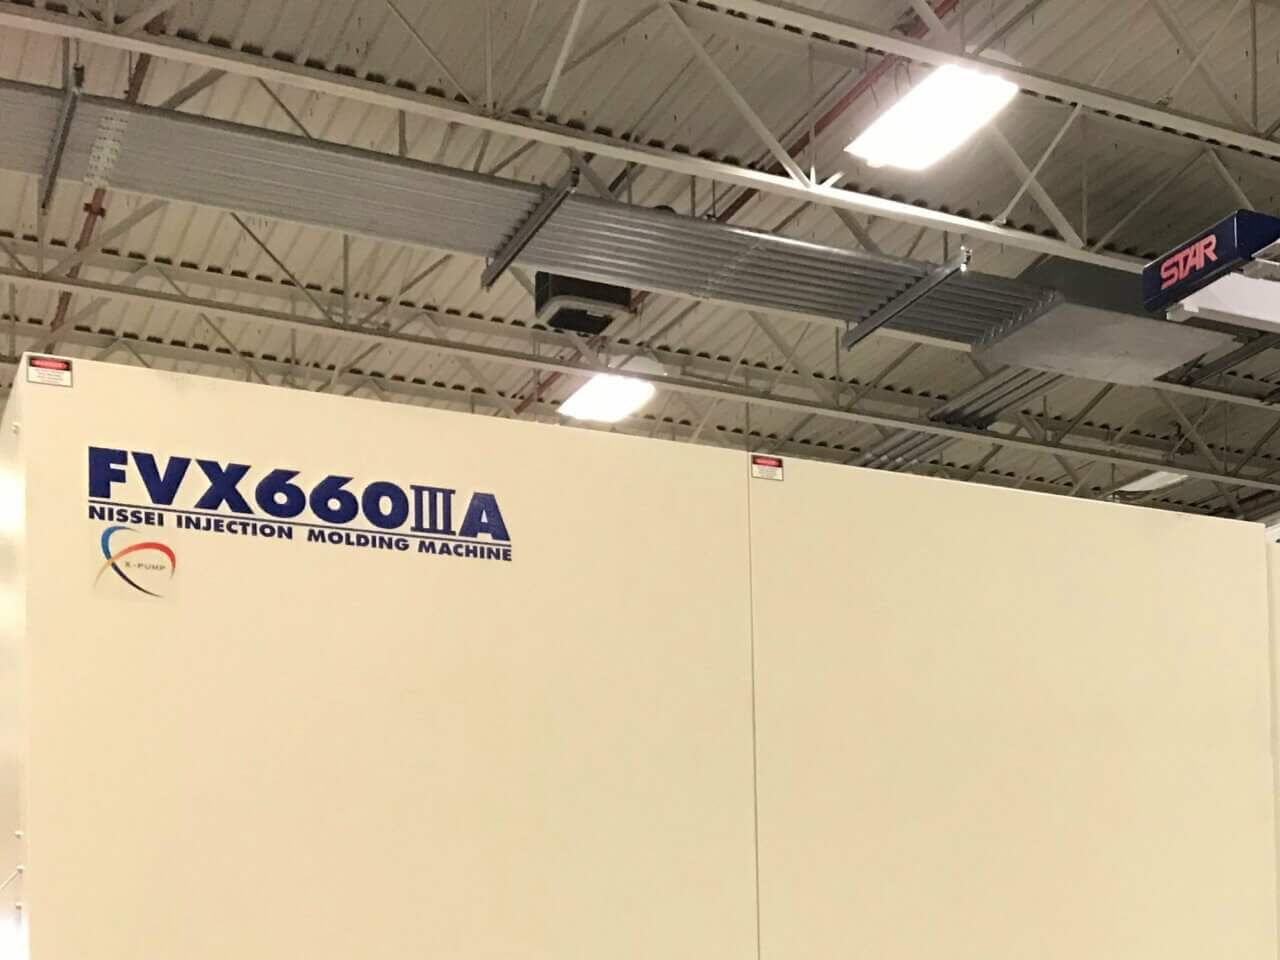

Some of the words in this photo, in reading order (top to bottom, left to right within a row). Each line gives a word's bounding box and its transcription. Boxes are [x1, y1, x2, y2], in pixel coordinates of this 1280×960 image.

[1161, 234, 1217, 290] STAR
[88, 506, 164, 527] NISSEI
[176, 515, 293, 540] INJECTION
[307, 529, 409, 551] MOLDING
[418, 540, 512, 561] MACHINE
